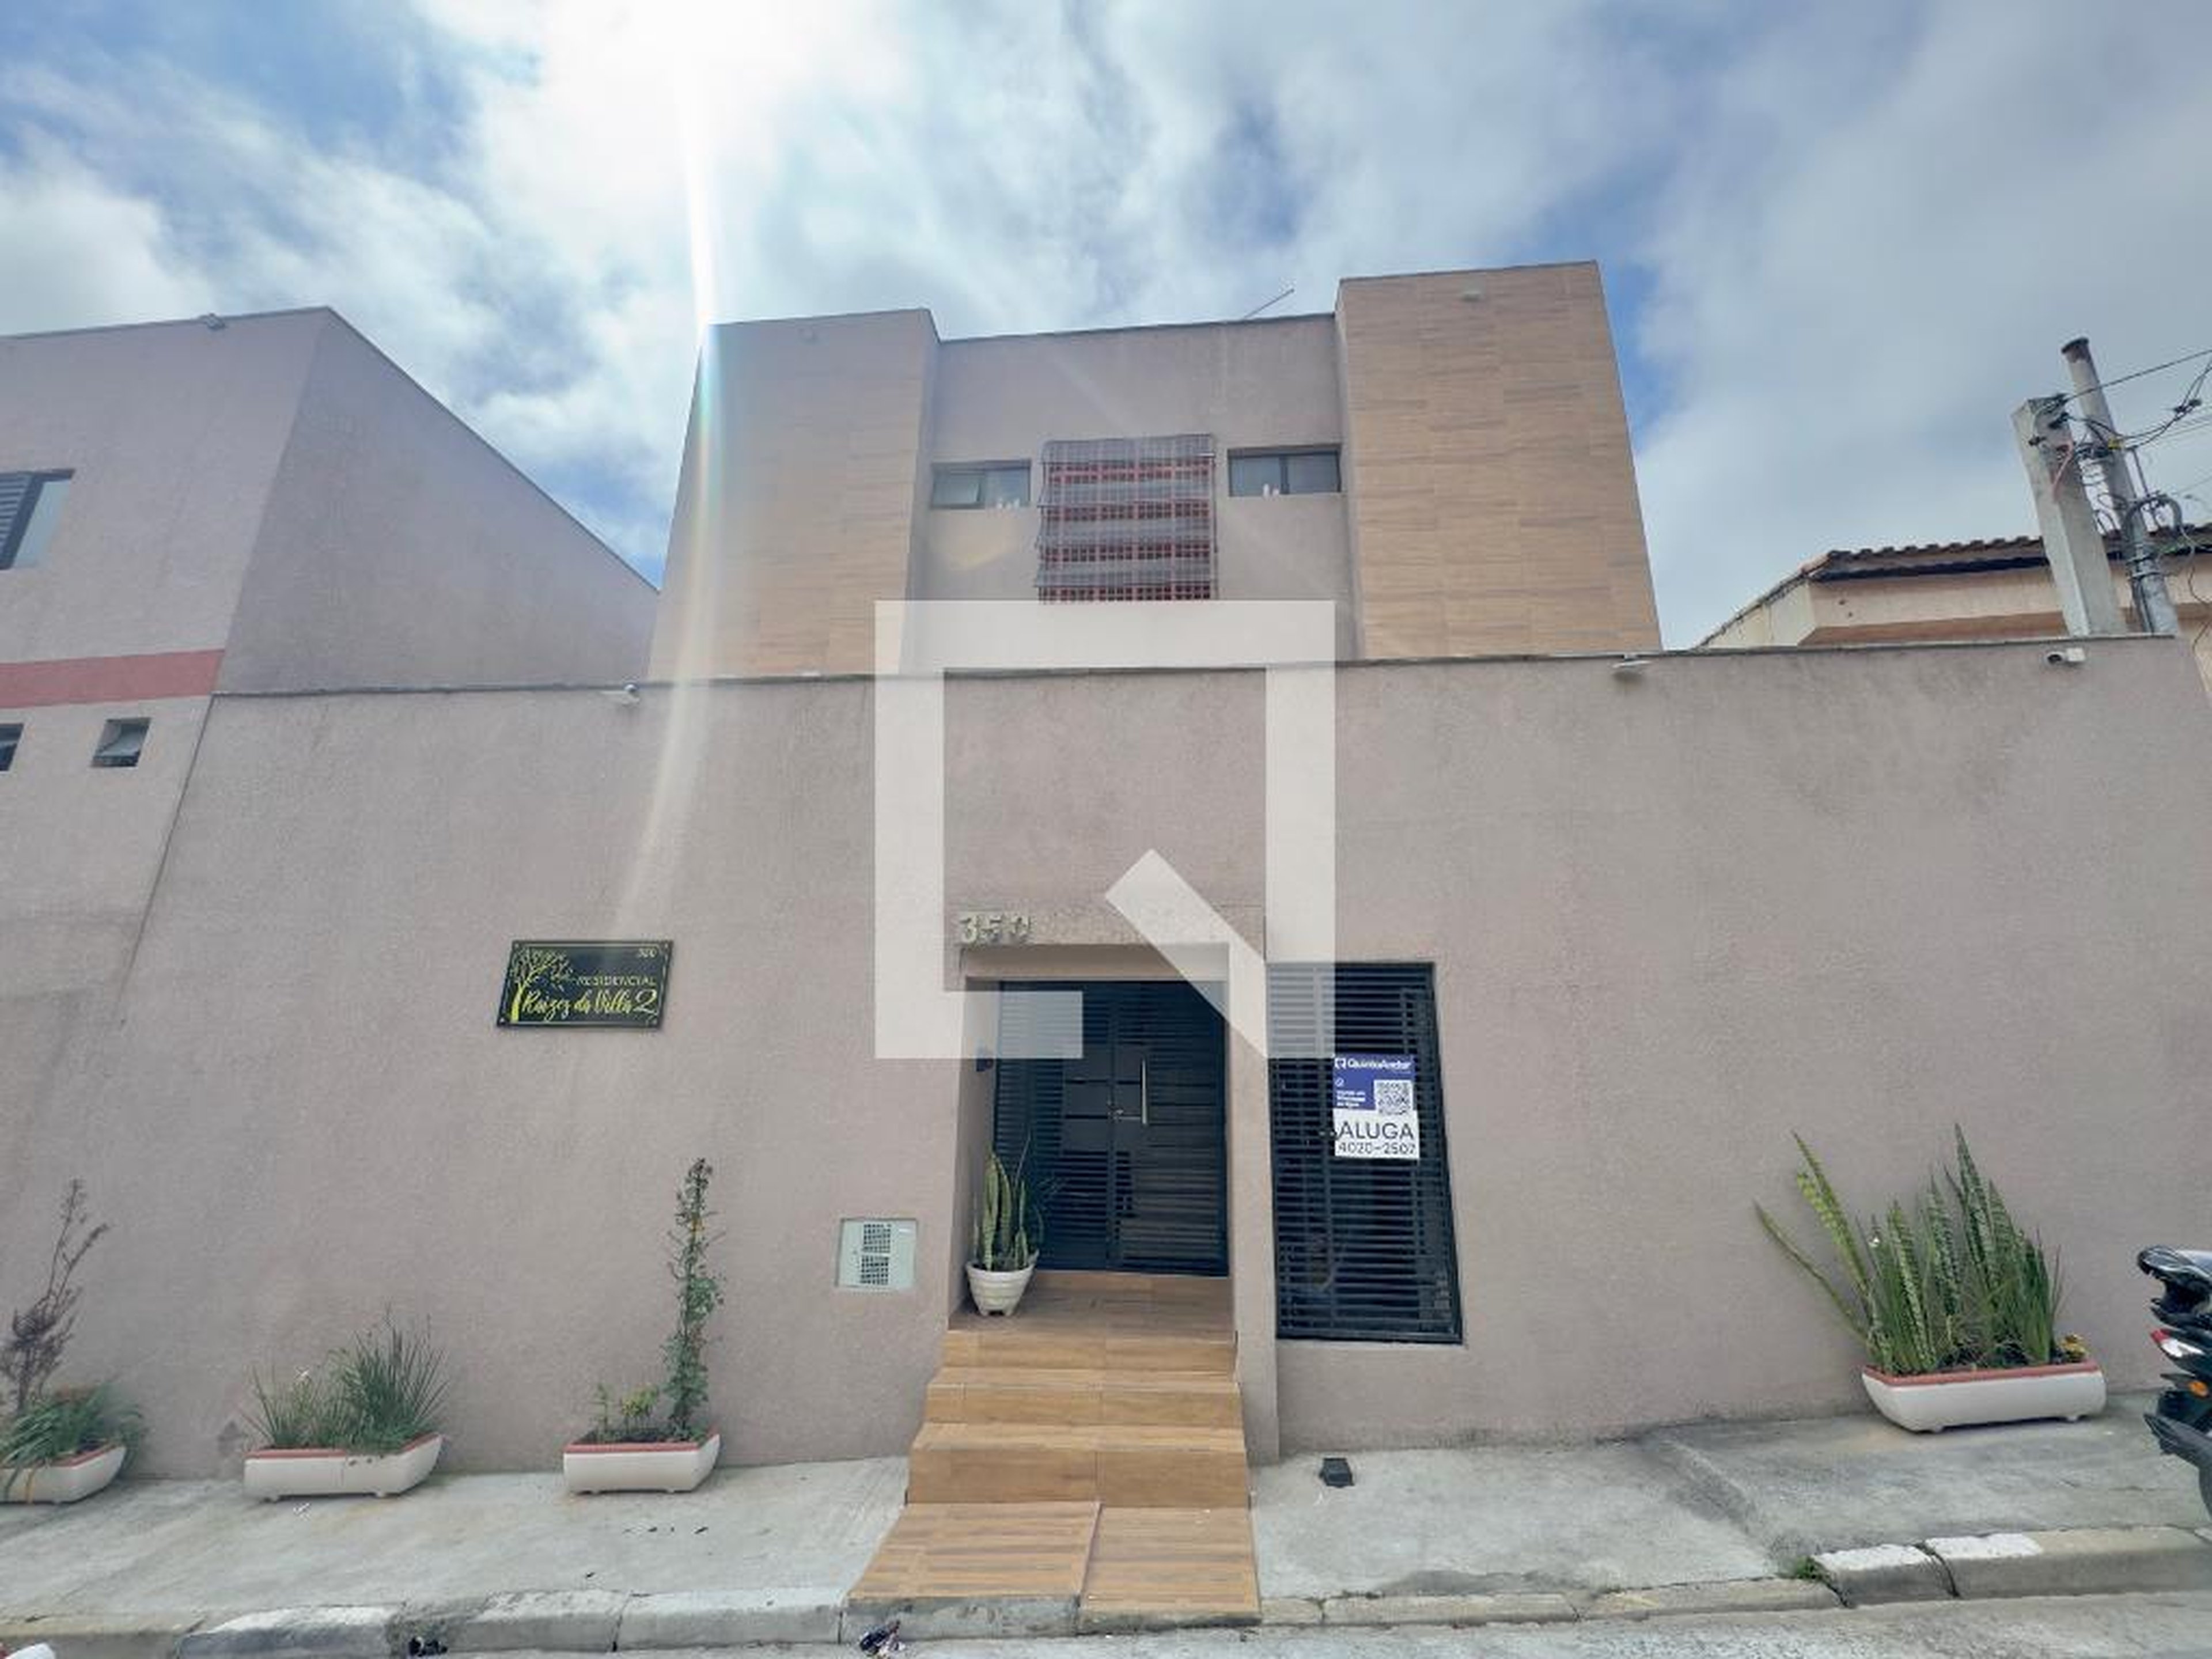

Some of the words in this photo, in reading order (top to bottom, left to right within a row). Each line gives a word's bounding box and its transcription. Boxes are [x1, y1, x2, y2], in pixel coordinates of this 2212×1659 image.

[577, 975, 657, 986] RESIDENCIAL
[633, 988, 658, 1016] 2
[1338, 1121, 1414, 1139] ALUGA
